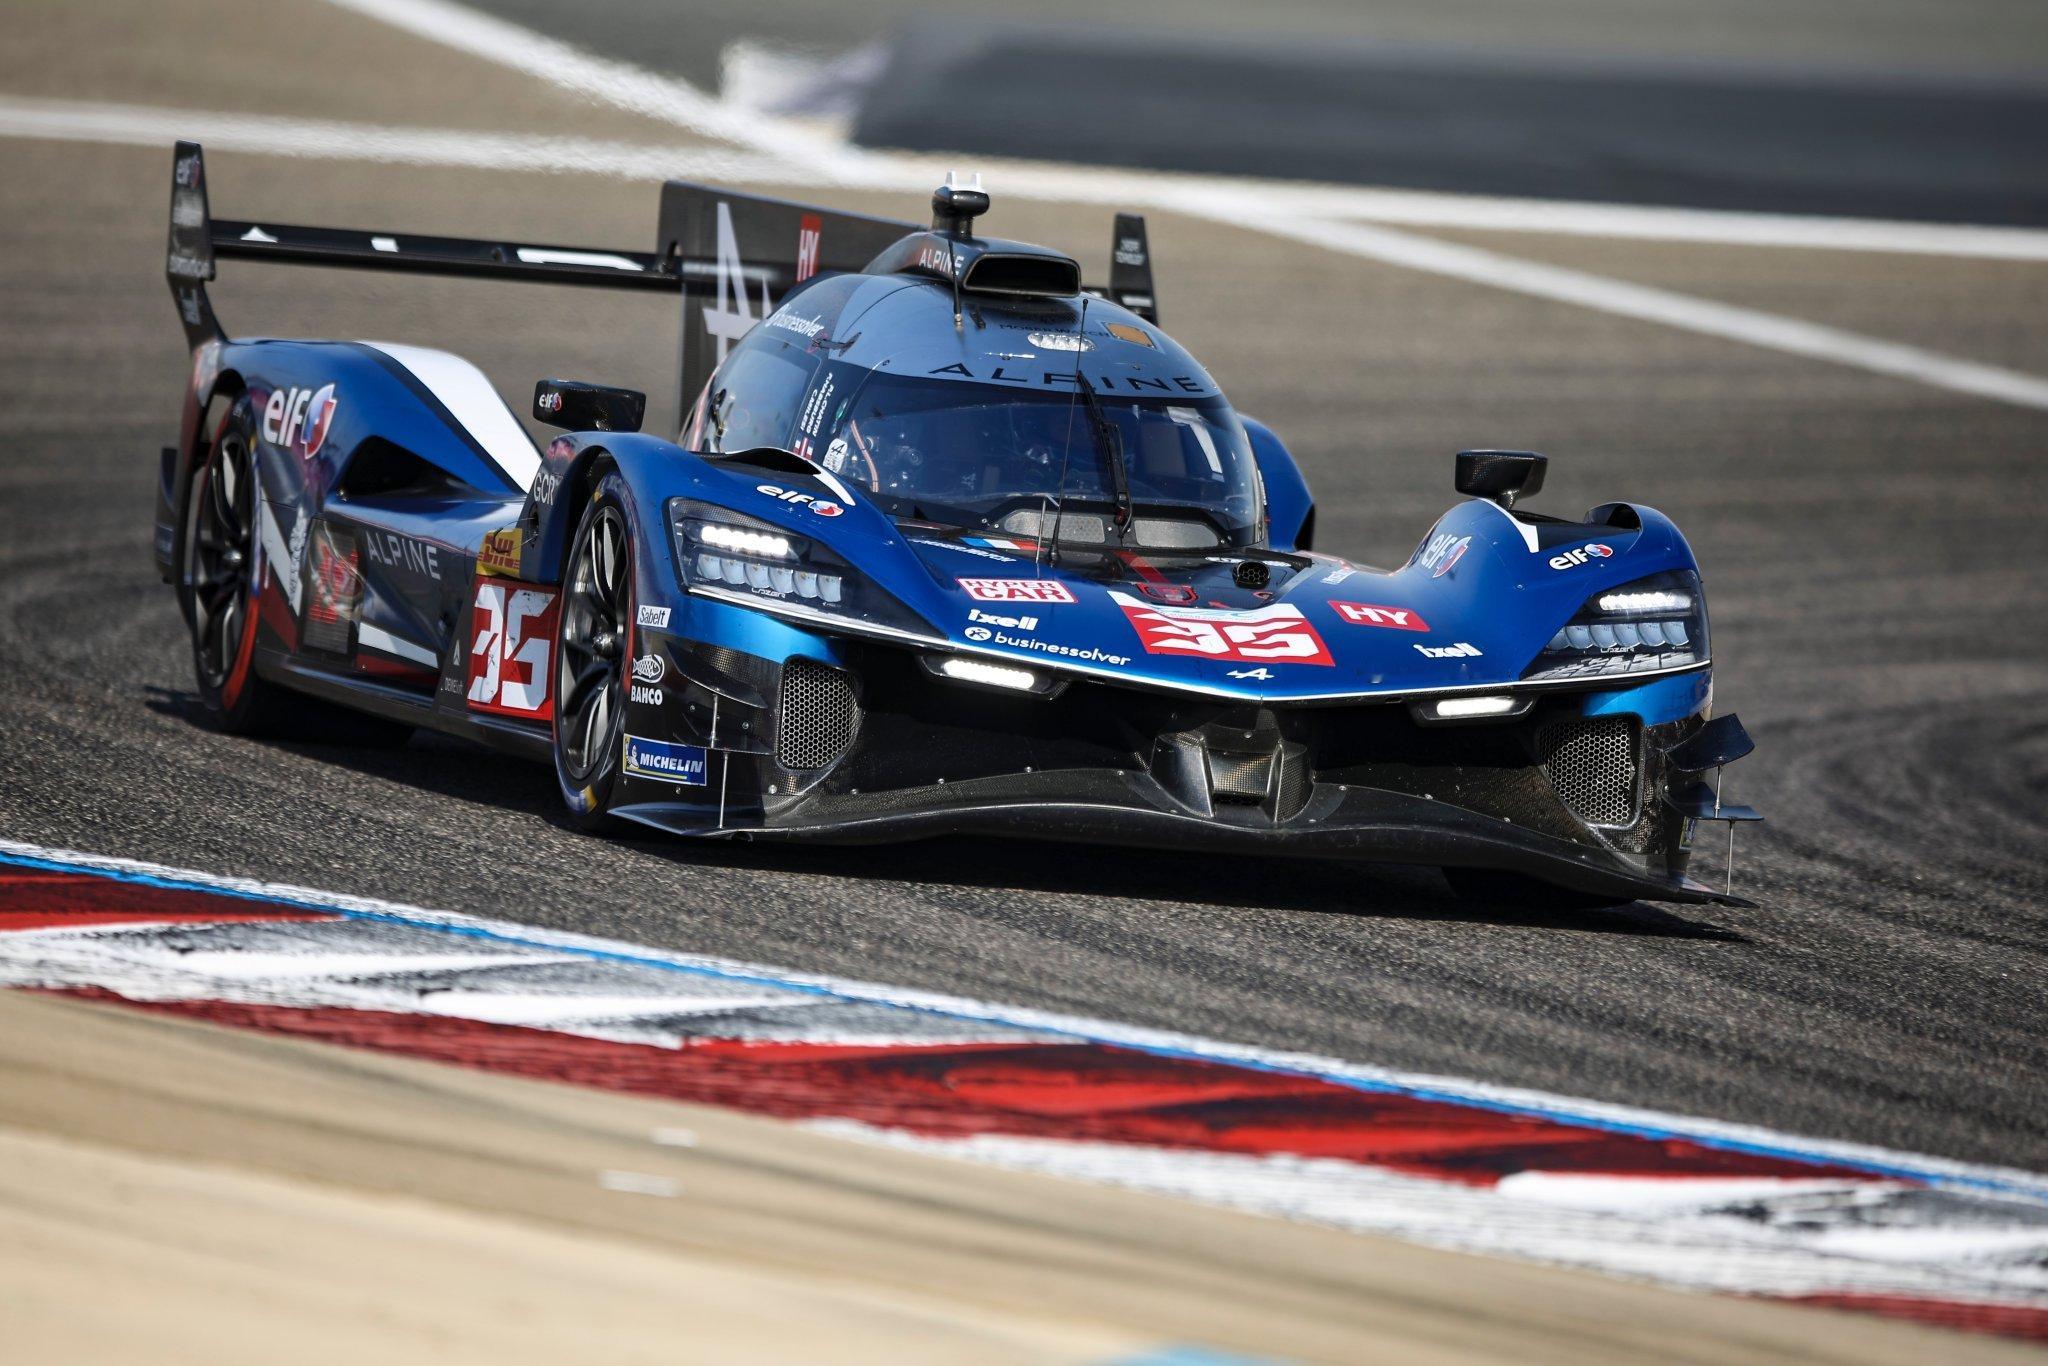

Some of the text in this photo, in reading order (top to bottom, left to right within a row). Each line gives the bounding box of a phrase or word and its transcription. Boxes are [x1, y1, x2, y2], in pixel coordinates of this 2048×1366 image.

[797, 229, 819, 281] HY
[918, 248, 965, 275] ALPINE
[928, 362, 1204, 393] ALPINE
[263, 387, 312, 448] elf
[757, 485, 815, 503] elf
[366, 531, 441, 580] ALPINE
[480, 532, 516, 568] DHL
[1549, 548, 1588, 570] elf
[964, 580, 1057, 590] HYPER
[974, 587, 1066, 600] CAR
[639, 606, 666, 626] Sabelt
[1340, 604, 1408, 625] HY
[467, 583, 556, 711] 35
[1133, 612, 1320, 658] 35
[995, 632, 1131, 666] businessolver
[631, 686, 663, 706] BAHCO
[640, 753, 703, 773] MICHELIN
